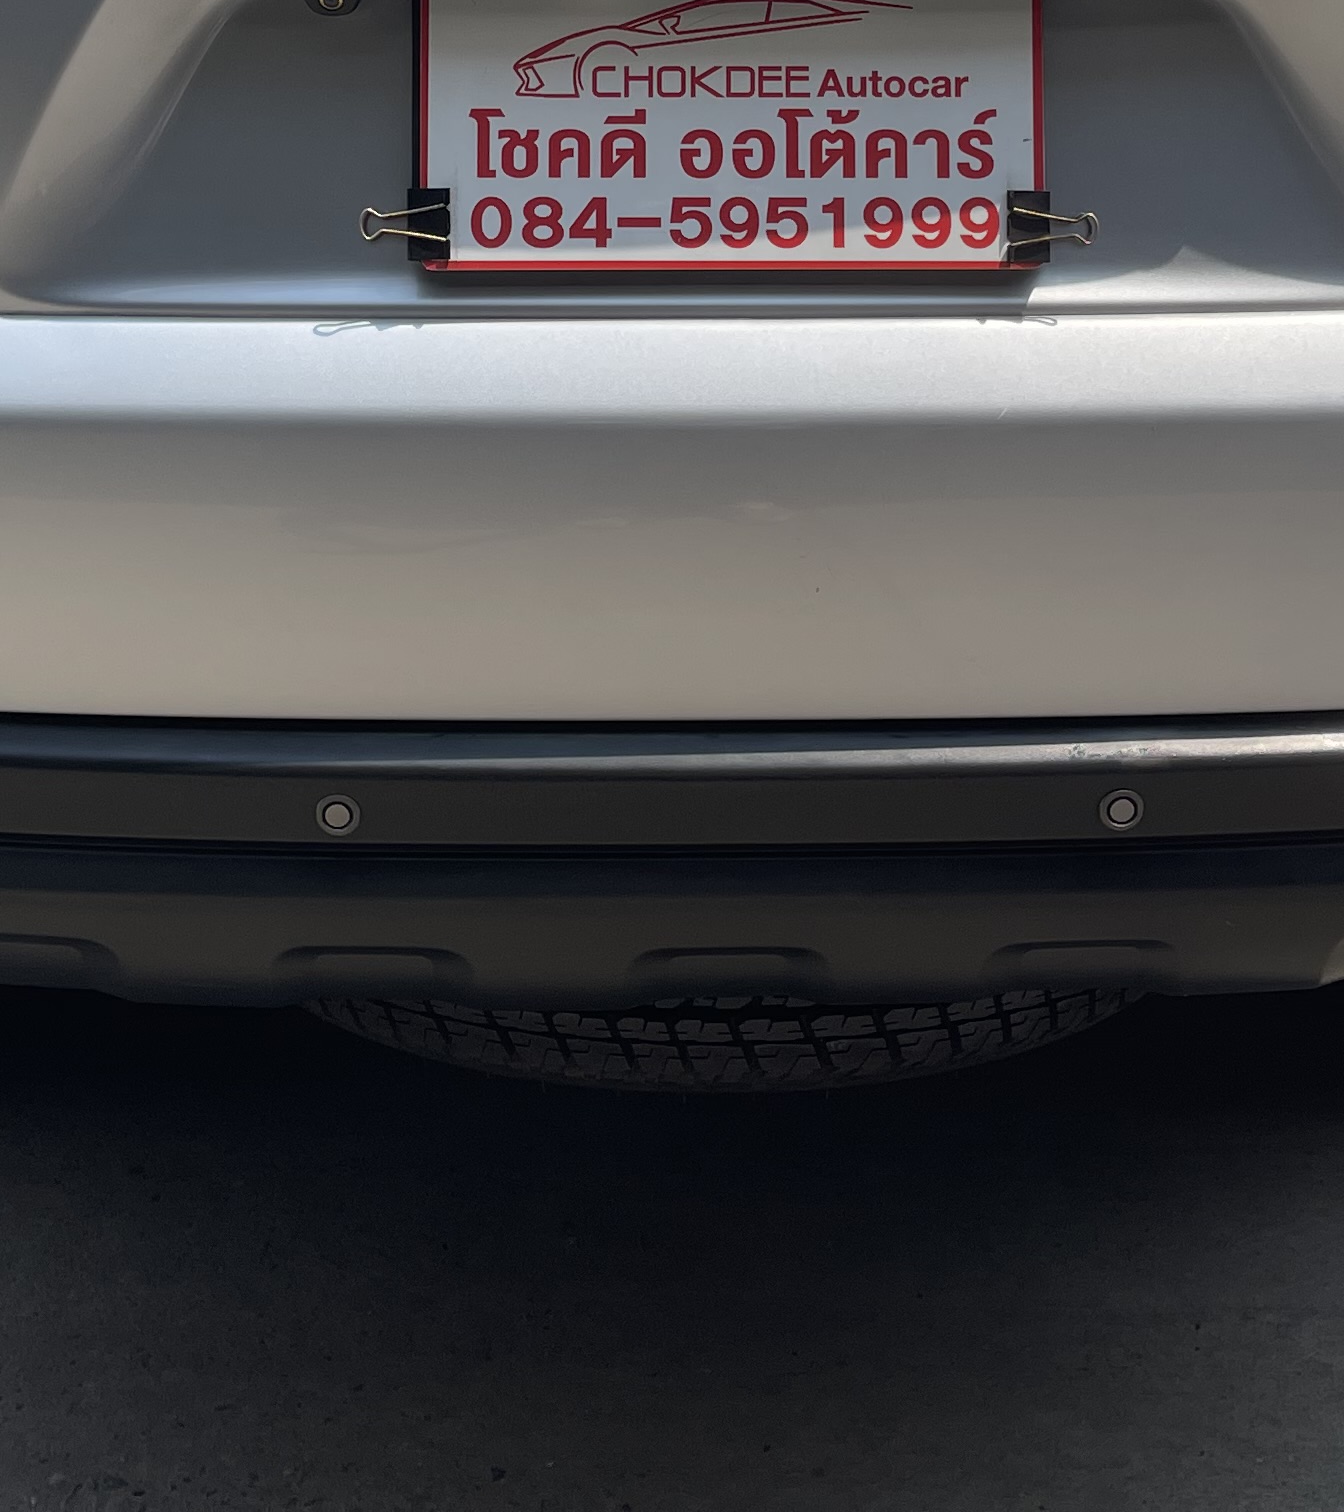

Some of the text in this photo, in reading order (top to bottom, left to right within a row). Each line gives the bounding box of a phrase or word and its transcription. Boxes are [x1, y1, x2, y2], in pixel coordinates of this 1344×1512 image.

[592, 65, 970, 99] CHOKDEE Autocar
[469, 107, 998, 180] โชคดี ออโต้คาร์
[470, 196, 1001, 250] 084-5951999
